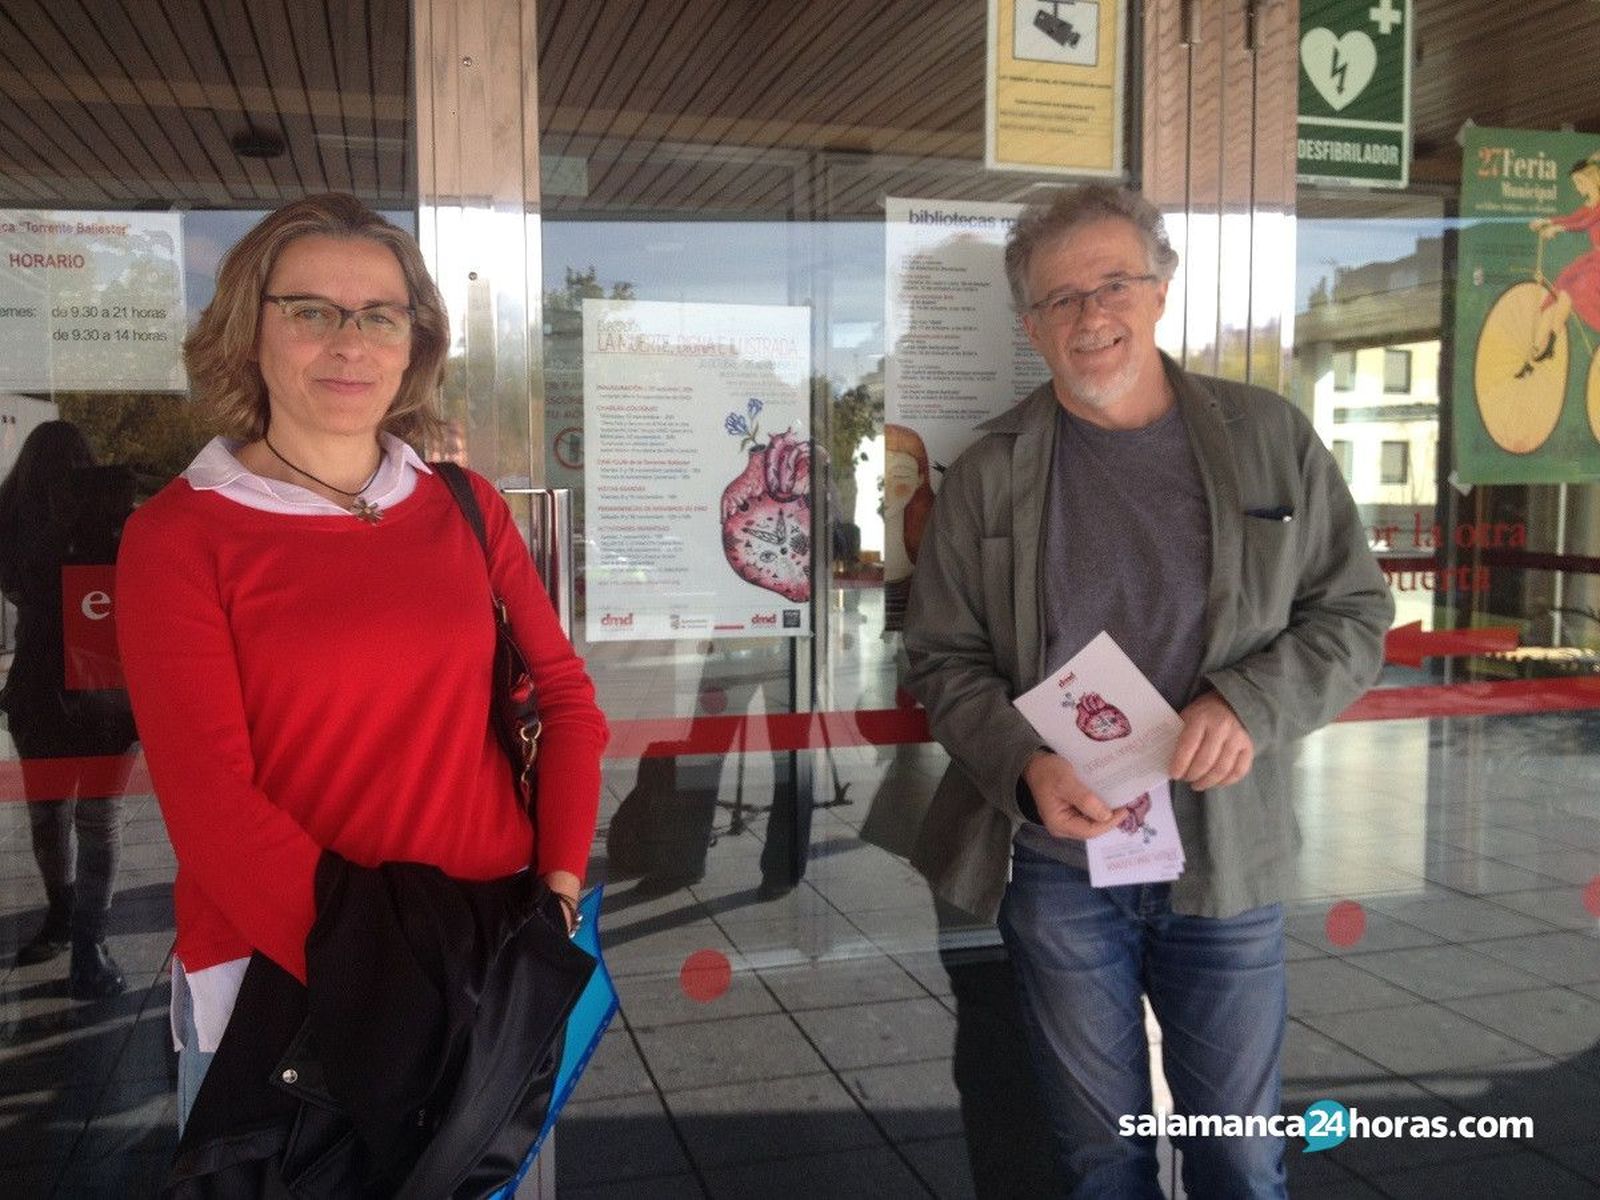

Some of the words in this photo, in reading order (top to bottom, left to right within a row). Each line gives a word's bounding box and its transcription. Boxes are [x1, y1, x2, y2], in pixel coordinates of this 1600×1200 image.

[1298, 138, 1400, 166] DESFIBRILADOR
[909, 210, 996, 227] bibliotecas
[52, 305, 68, 318] de
[71, 306, 98, 318] 9.30
[101, 308, 109, 318] a
[112, 307, 128, 318] 21
[131, 305, 167, 319] horas
[53, 328, 68, 341] de
[72, 329, 99, 341] 9.30
[102, 331, 111, 341] a
[114, 329, 129, 341] 14
[133, 329, 167, 342] horas
[1413, 512, 1441, 547] la
[1454, 521, 1527, 547] otra
[601, 613, 634, 626] dmd
[751, 614, 777, 625] dmd
